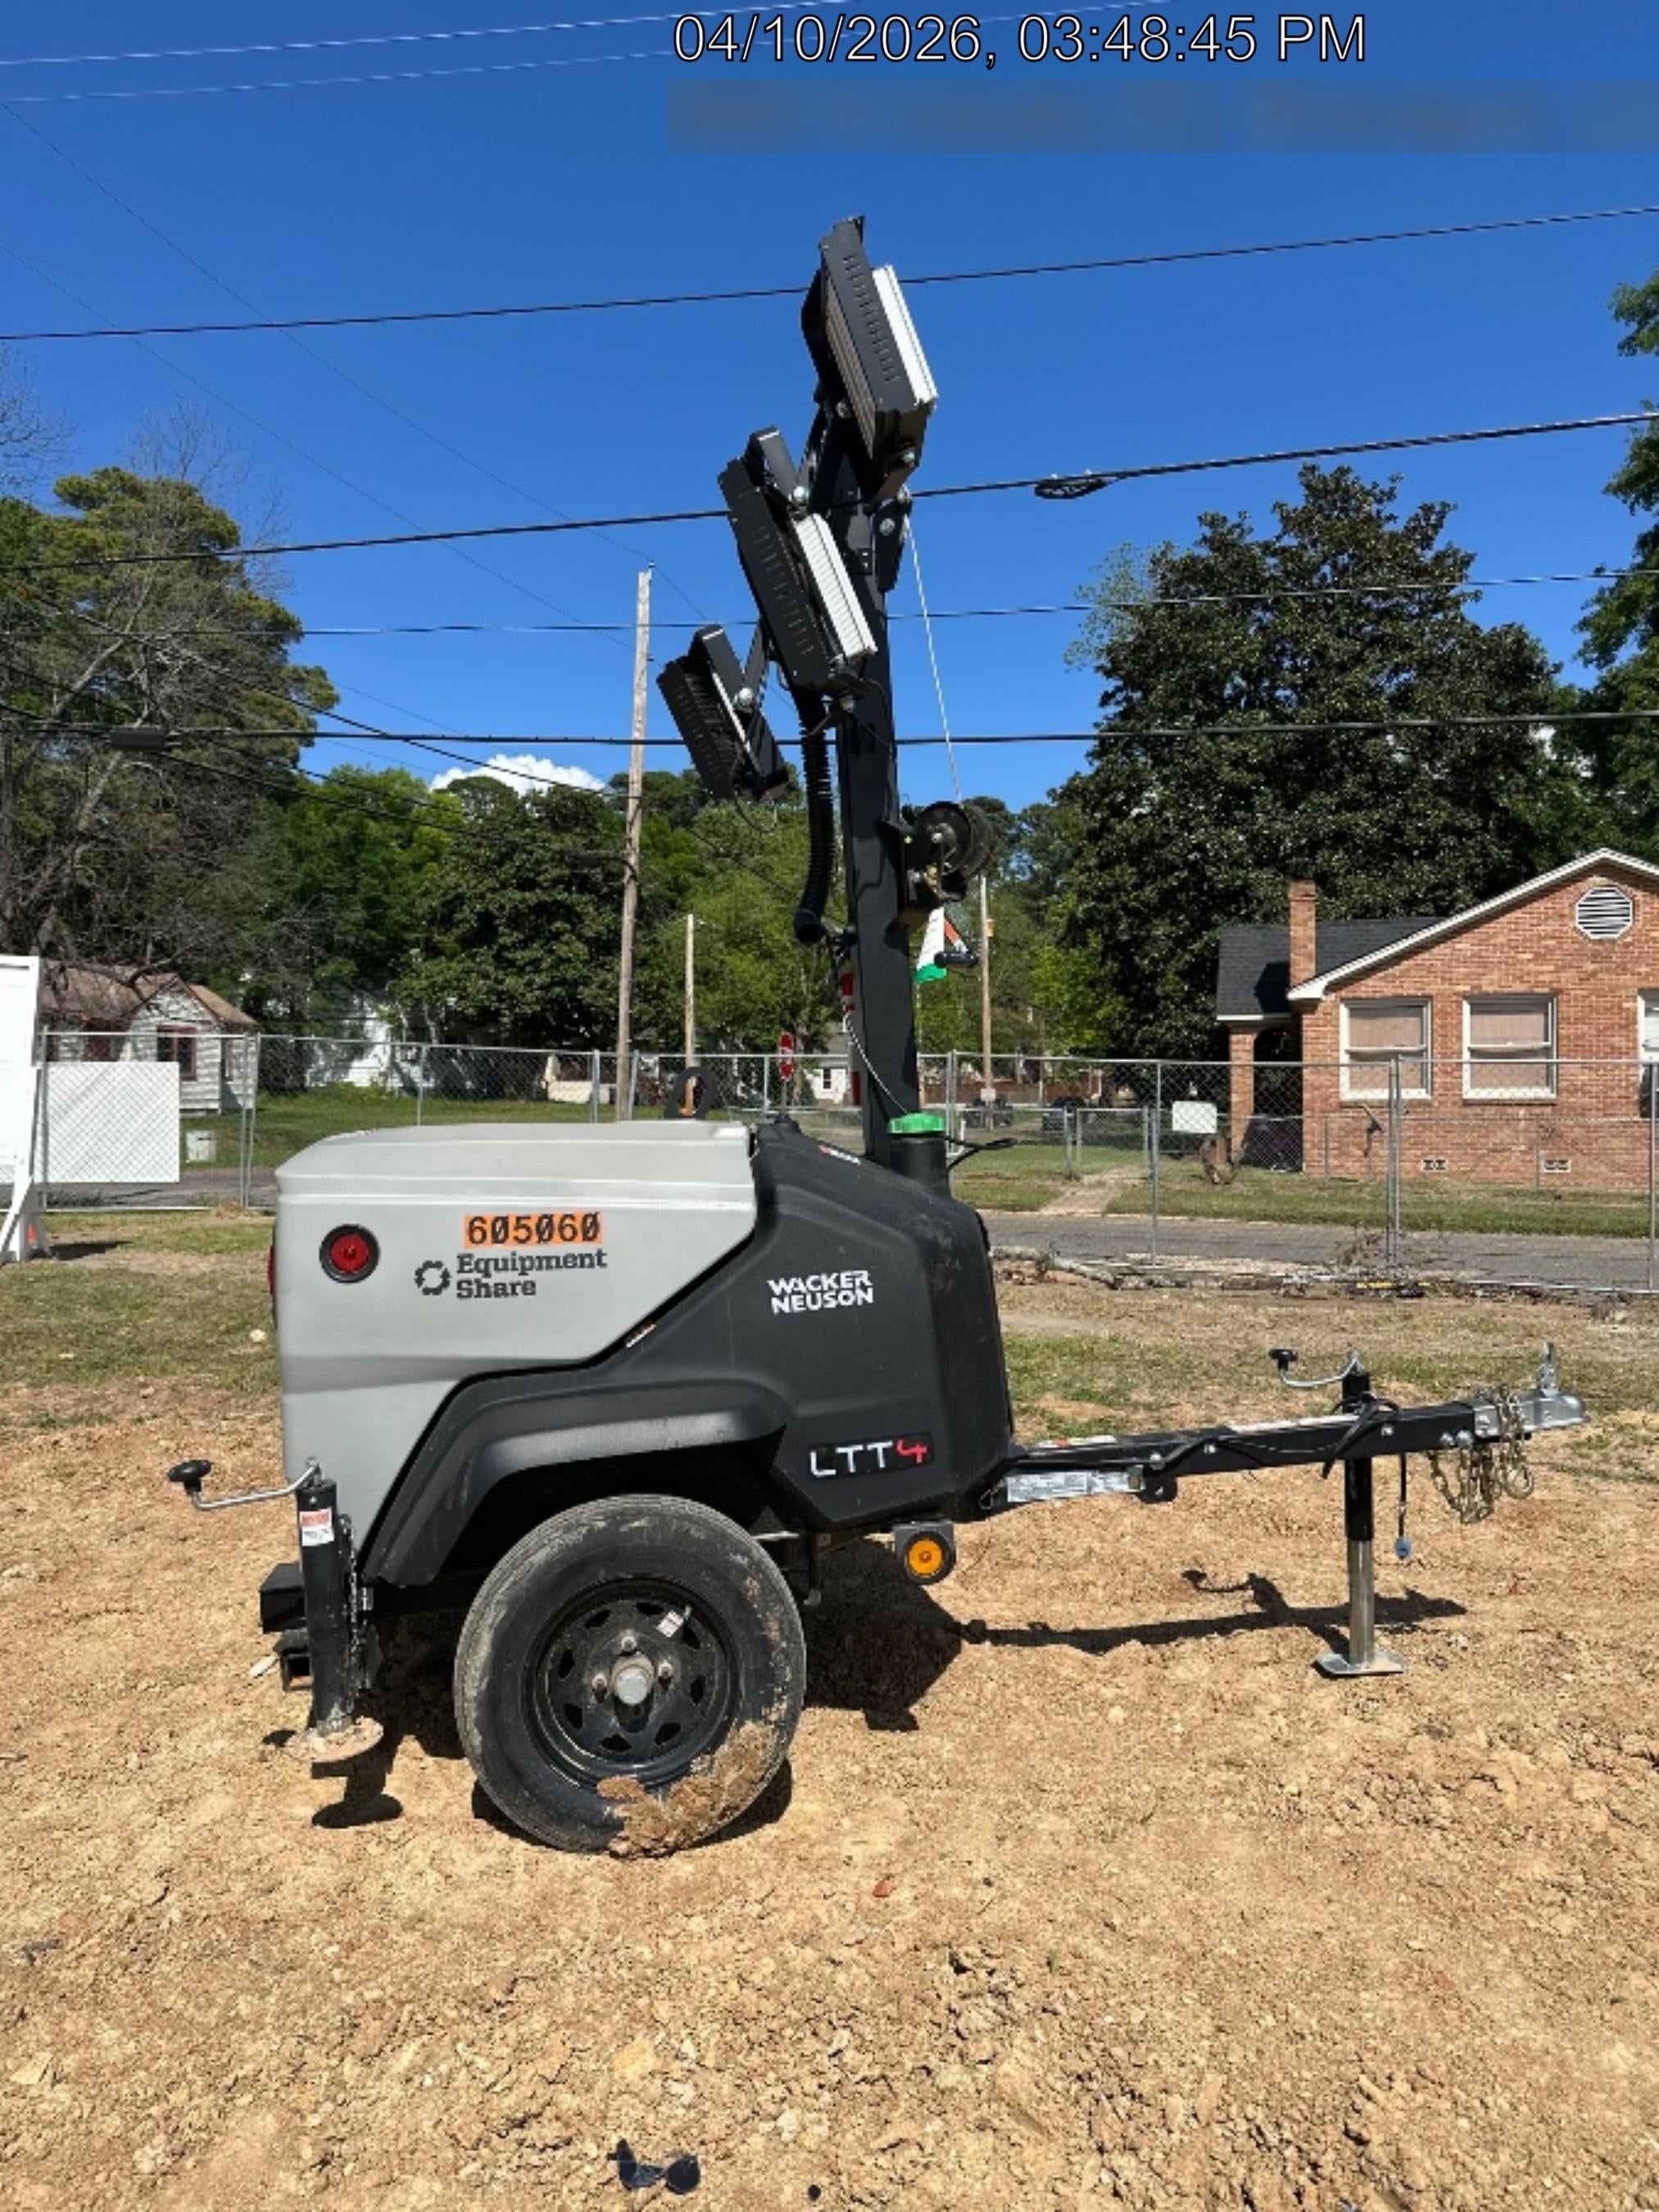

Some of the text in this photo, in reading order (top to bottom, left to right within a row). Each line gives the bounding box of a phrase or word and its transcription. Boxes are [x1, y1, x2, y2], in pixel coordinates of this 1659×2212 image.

[468, 1212, 601, 1245] 605060
[456, 1249, 607, 1278] Equipment
[456, 1279, 537, 1299] Share
[767, 1270, 873, 1295] WACKER
[771, 1287, 873, 1315] NEUSON
[809, 1439, 928, 1478] LTT4
